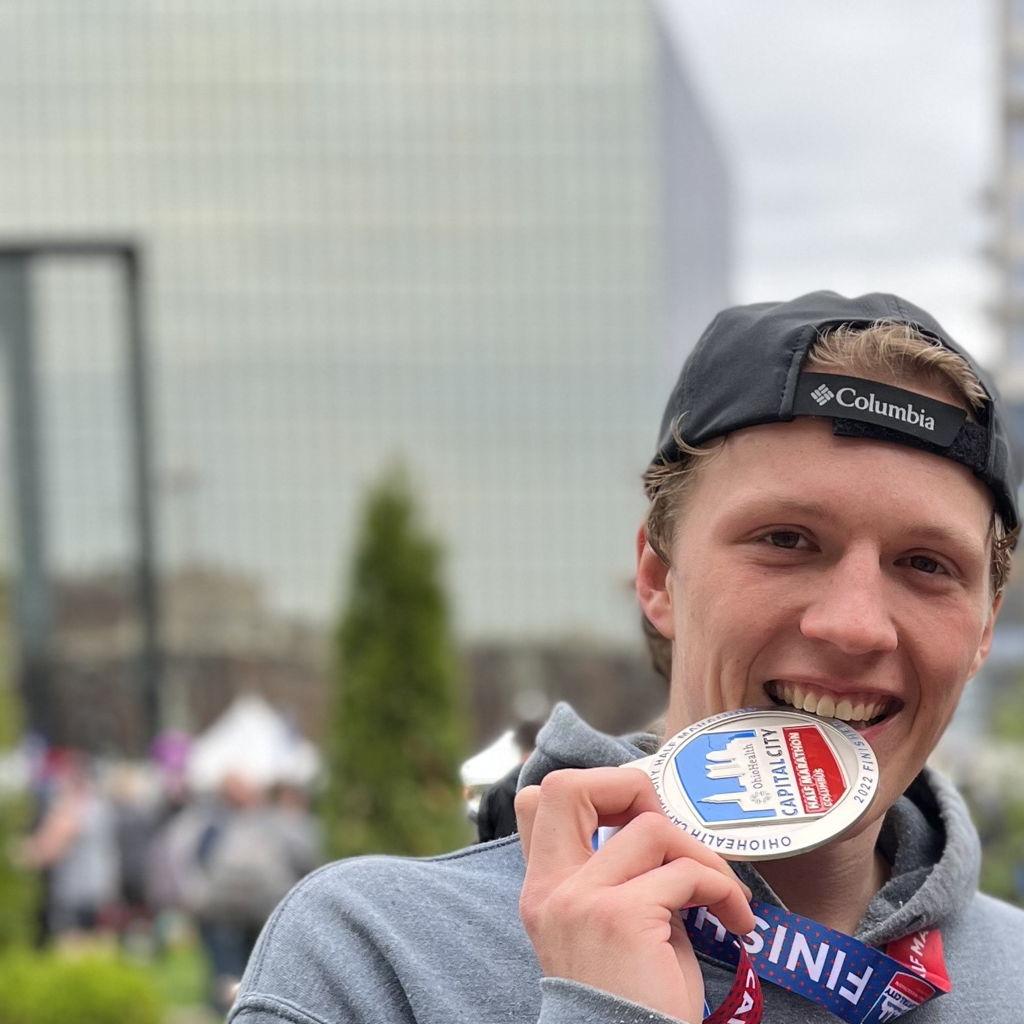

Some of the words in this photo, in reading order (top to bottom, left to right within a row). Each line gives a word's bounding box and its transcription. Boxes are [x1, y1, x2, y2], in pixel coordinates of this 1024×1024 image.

[836, 387, 935, 431] Columbia
[743, 743, 763, 790] OhioHealth
[787, 731, 813, 785] MARATHON
[801, 785, 821, 810] HALF
[811, 767, 833, 808] COLUMBUS
[853, 776, 873, 804] 2022
